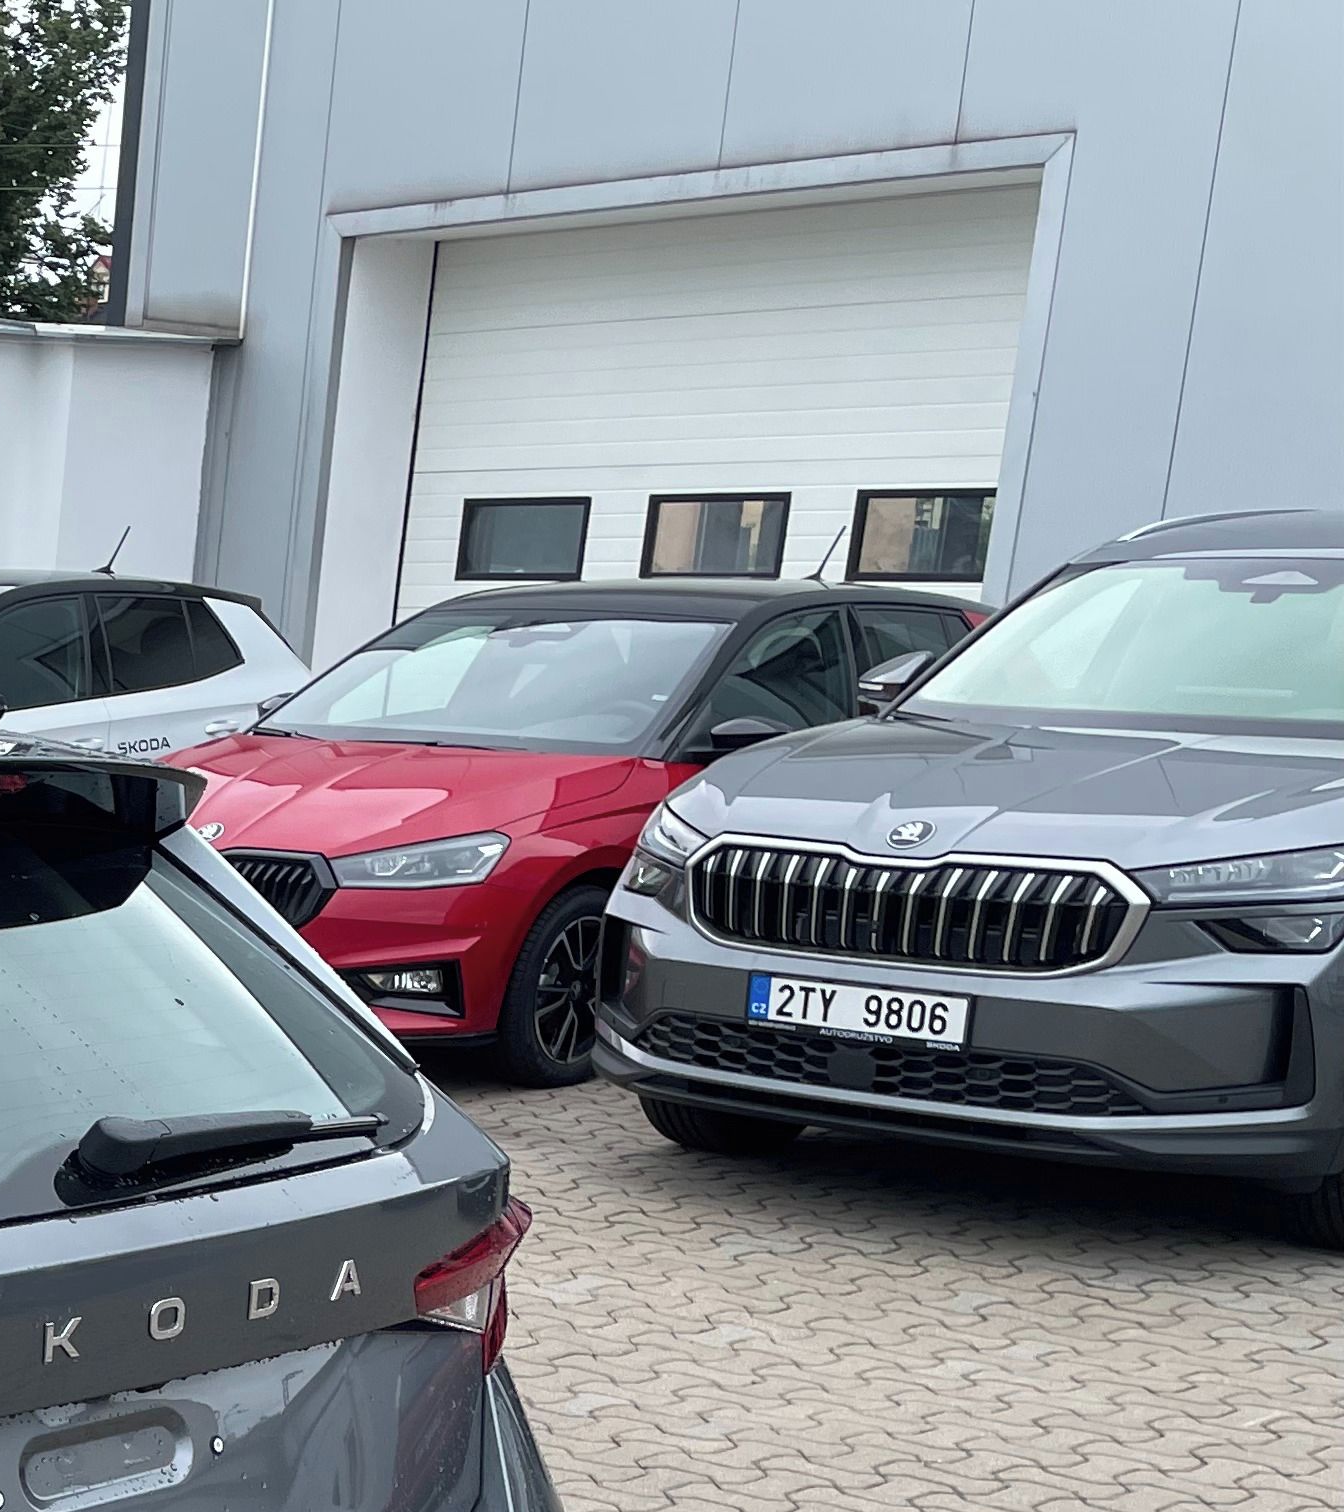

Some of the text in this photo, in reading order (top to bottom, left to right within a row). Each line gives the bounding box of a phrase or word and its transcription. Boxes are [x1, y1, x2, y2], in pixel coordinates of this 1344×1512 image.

[751, 1002, 767, 1014] CZ
[775, 984, 950, 1036] 2TY 9806
